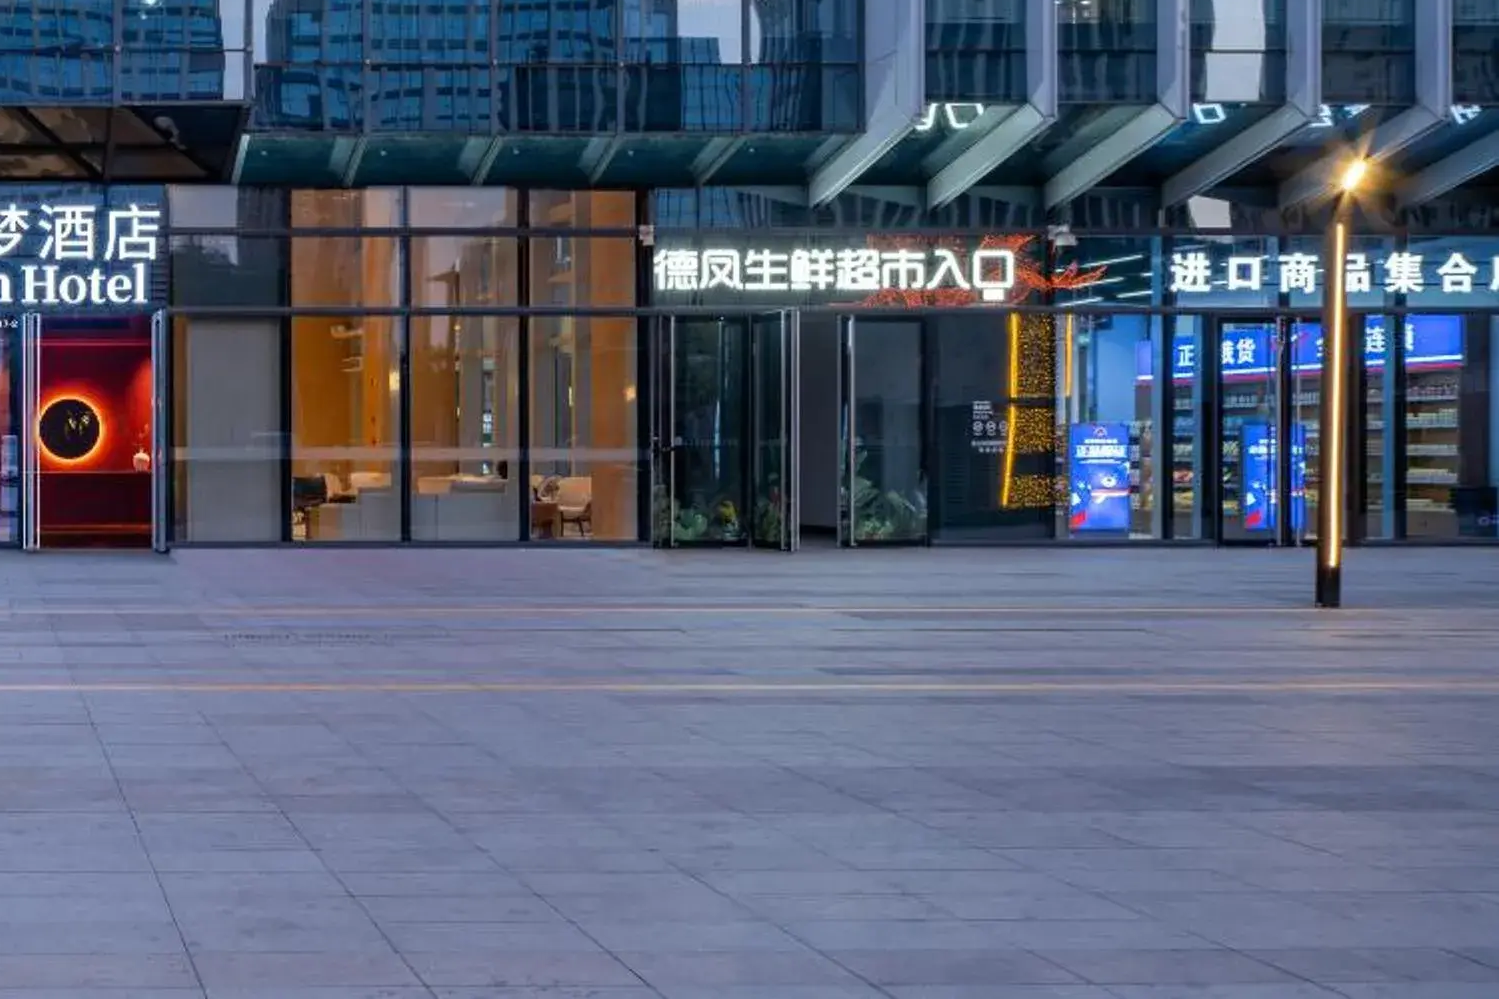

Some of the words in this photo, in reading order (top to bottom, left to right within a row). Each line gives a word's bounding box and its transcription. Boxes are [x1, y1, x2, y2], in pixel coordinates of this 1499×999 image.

[21, 263, 148, 304] Hotel
[653, 248, 1015, 291] 德凤生鲜超市入口
[1170, 252, 1499, 293] 进口商品集合
